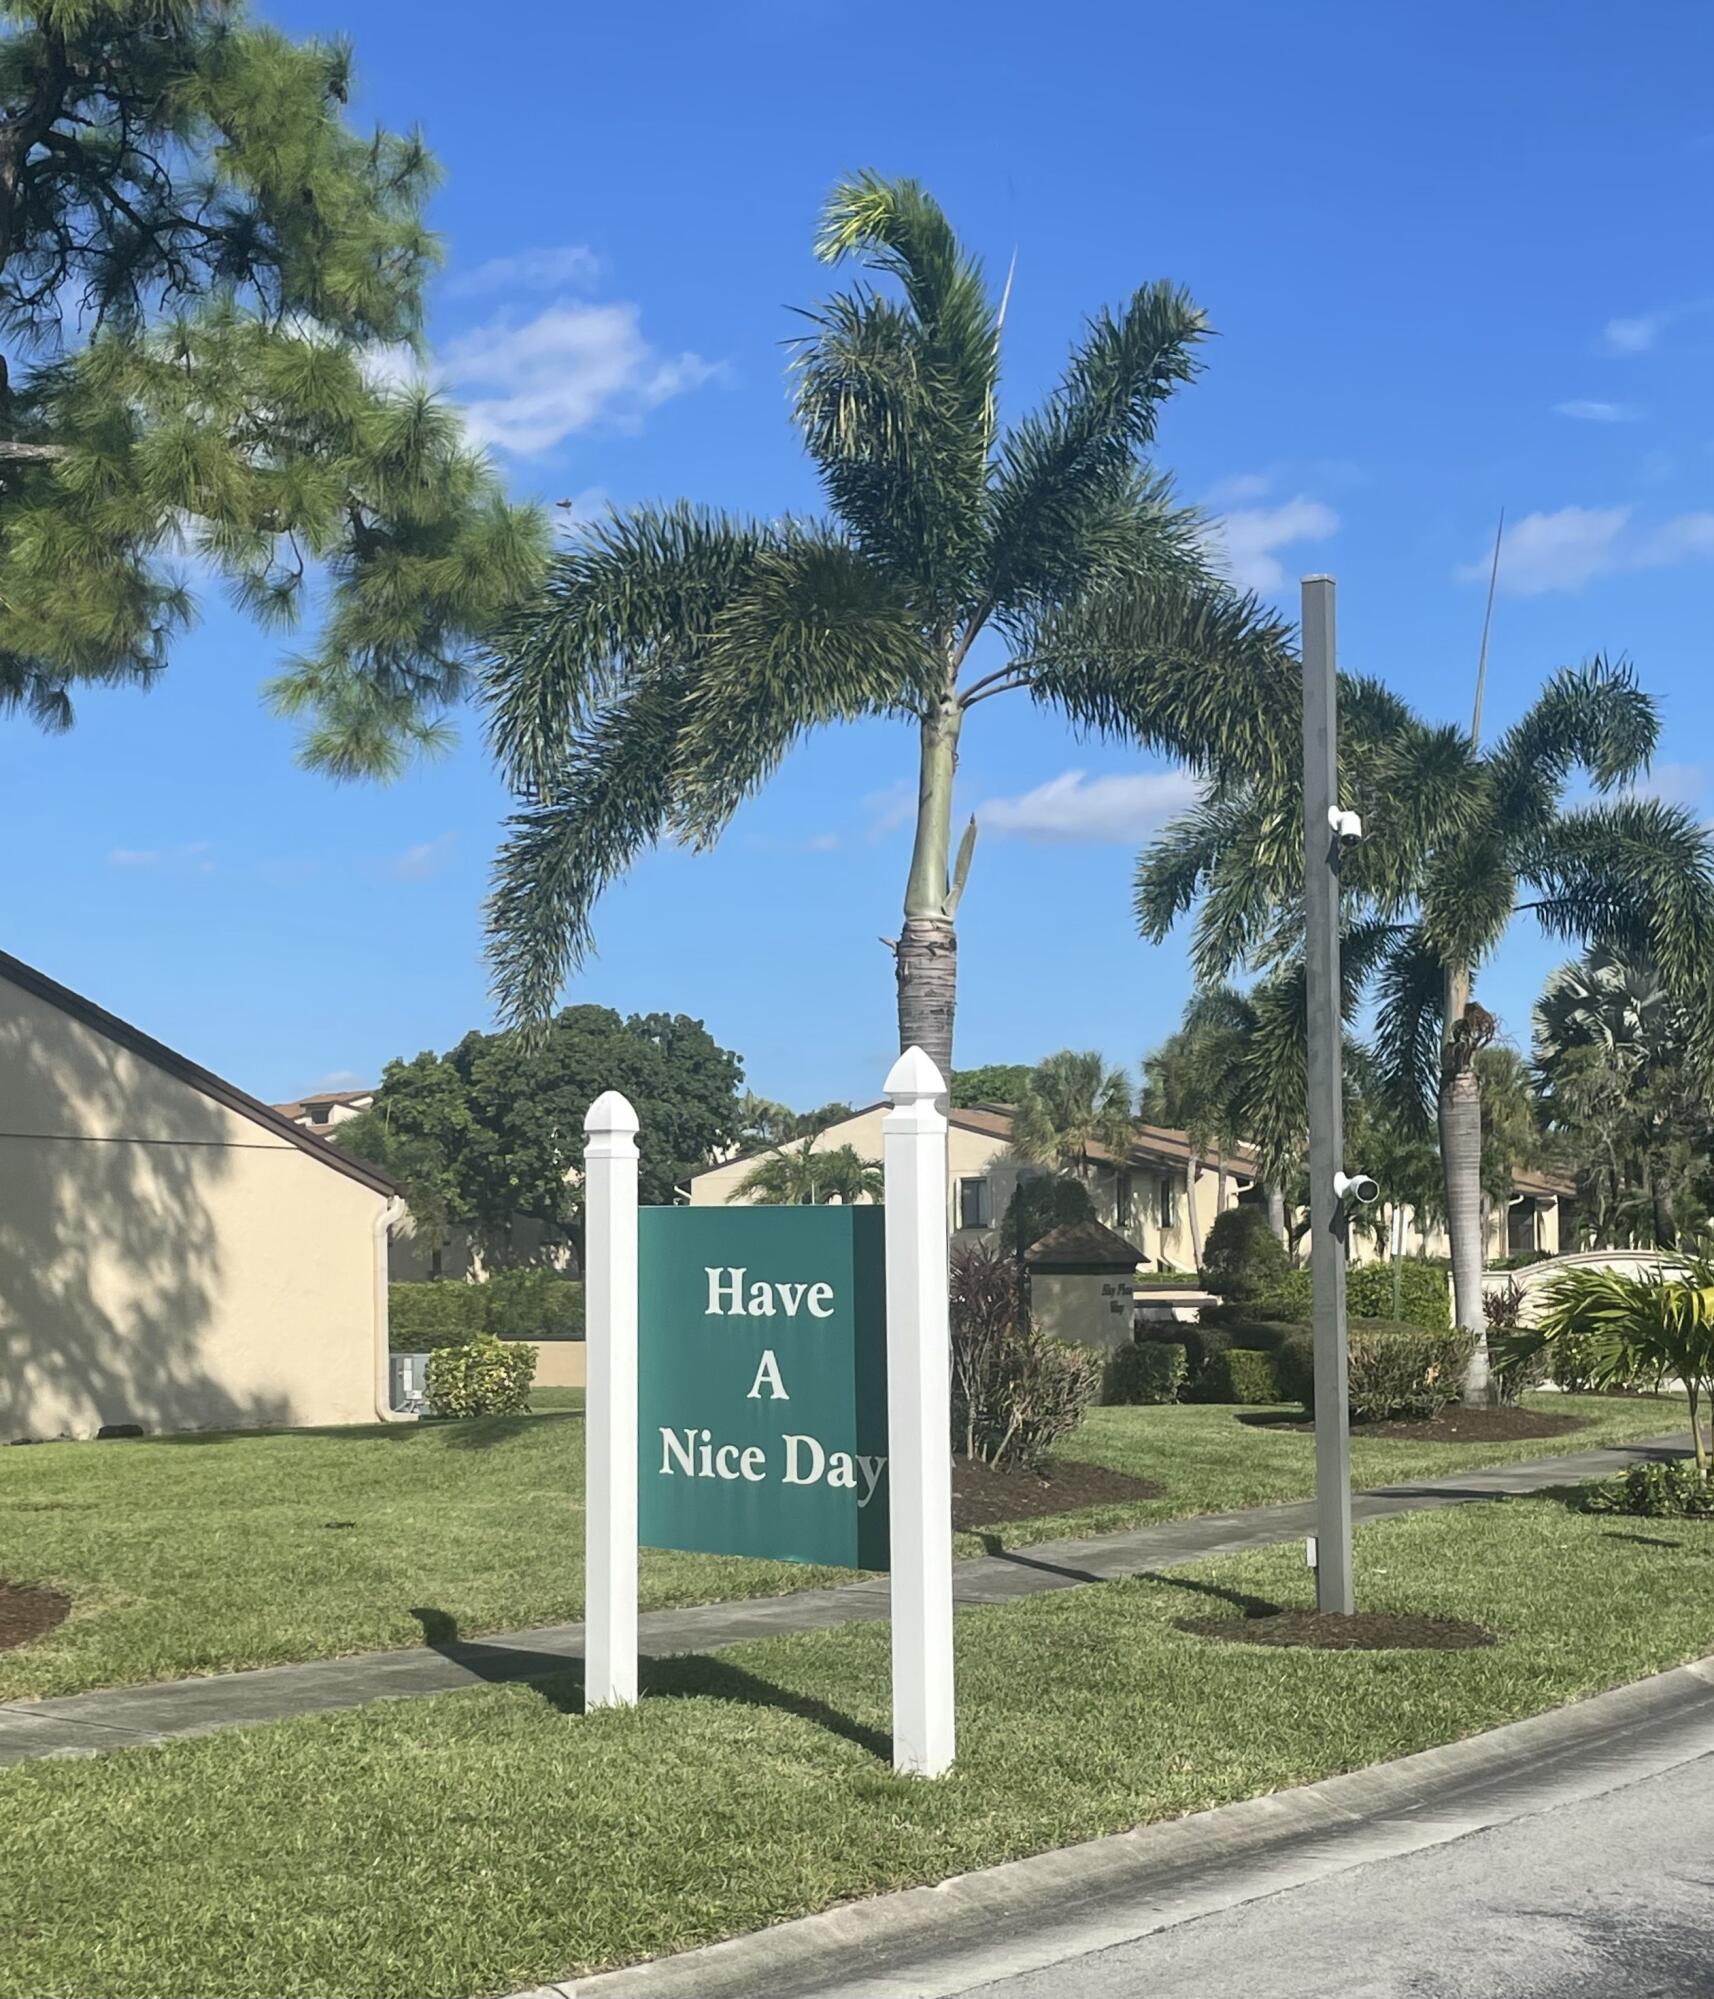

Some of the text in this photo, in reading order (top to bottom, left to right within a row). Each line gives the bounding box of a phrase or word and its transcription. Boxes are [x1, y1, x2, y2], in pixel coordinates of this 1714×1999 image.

[704, 1266, 835, 1318] Have
[746, 1349, 790, 1400] A
[658, 1427, 888, 1508] Nice Day
